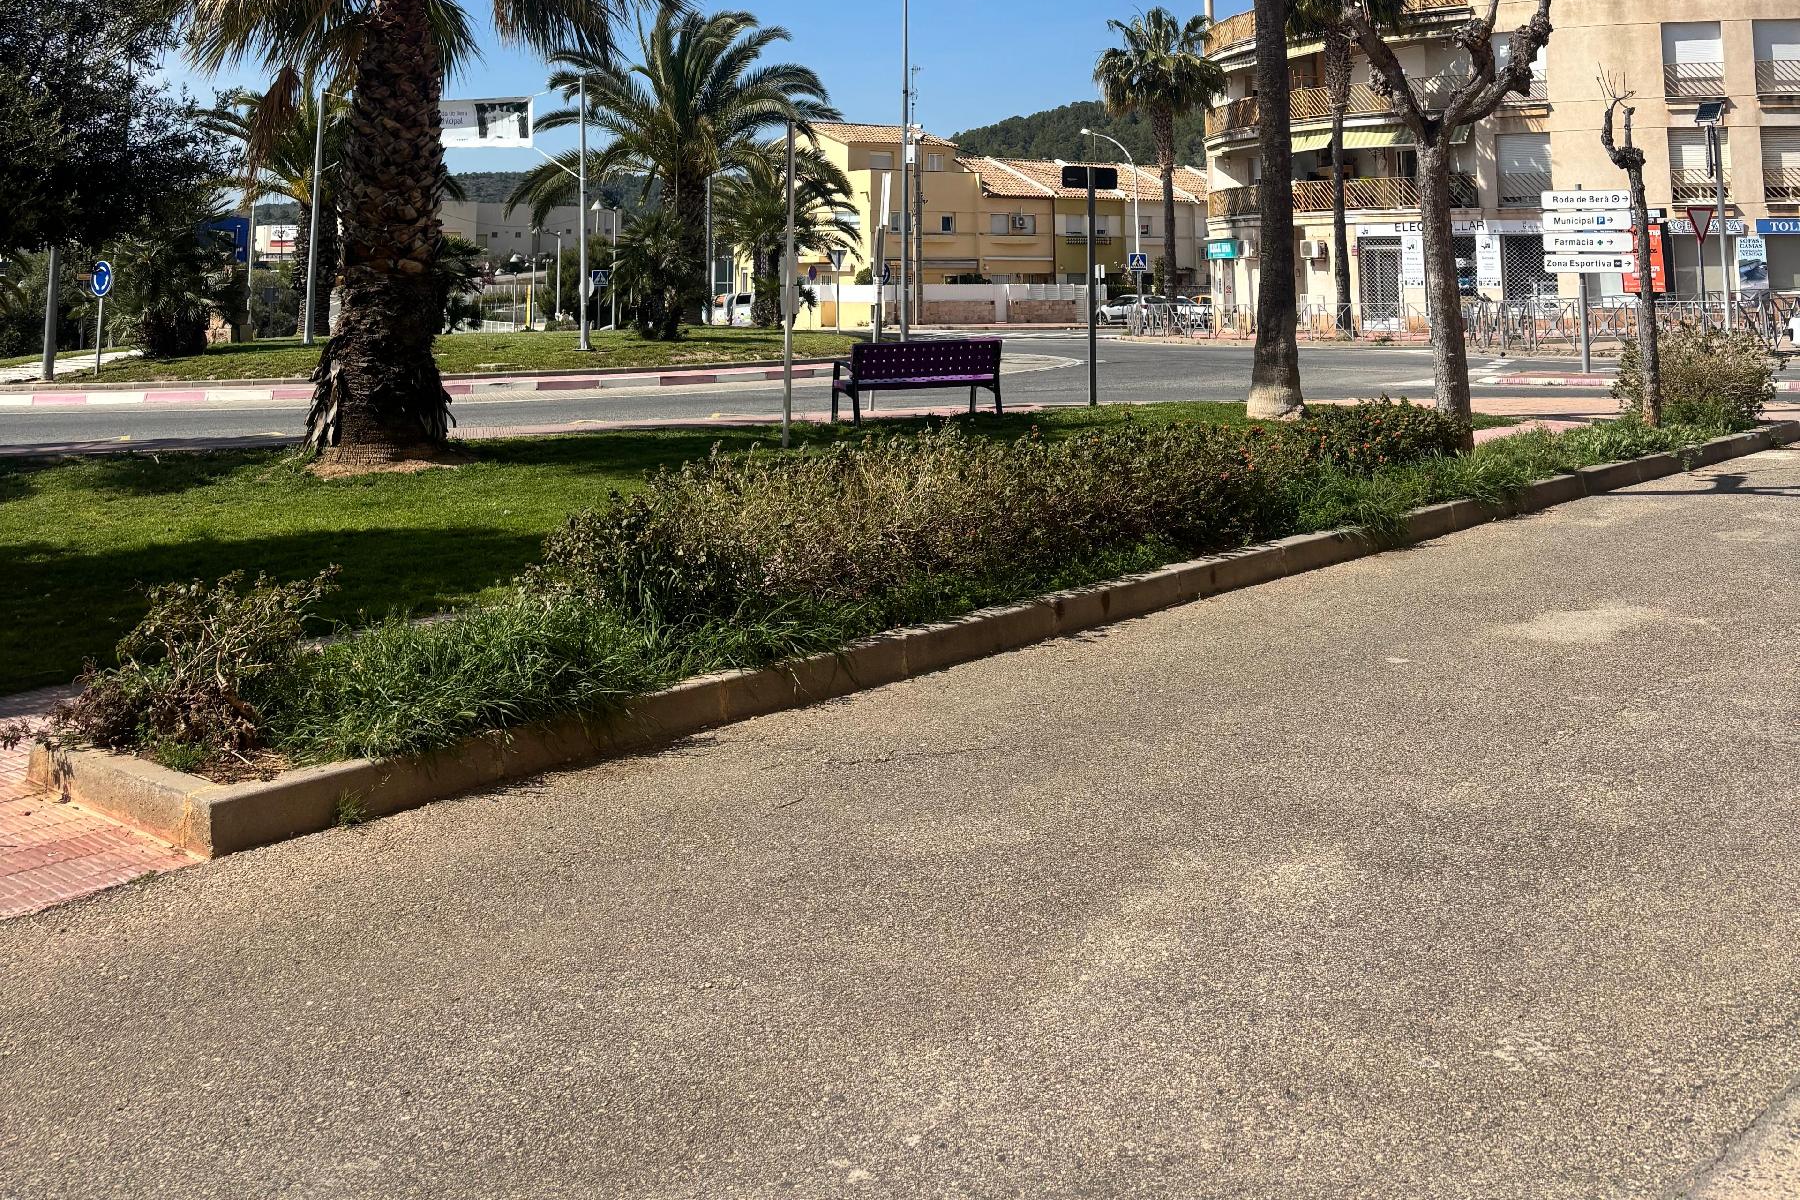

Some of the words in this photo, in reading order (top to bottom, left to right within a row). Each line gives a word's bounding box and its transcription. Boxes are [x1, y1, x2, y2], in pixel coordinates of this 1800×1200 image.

[1553, 217, 1594, 226] Municipal
[1554, 238, 1594, 246] Farmàcia
[1546, 259, 1568, 267] Zona
[1569, 259, 1612, 268] Esportiva
